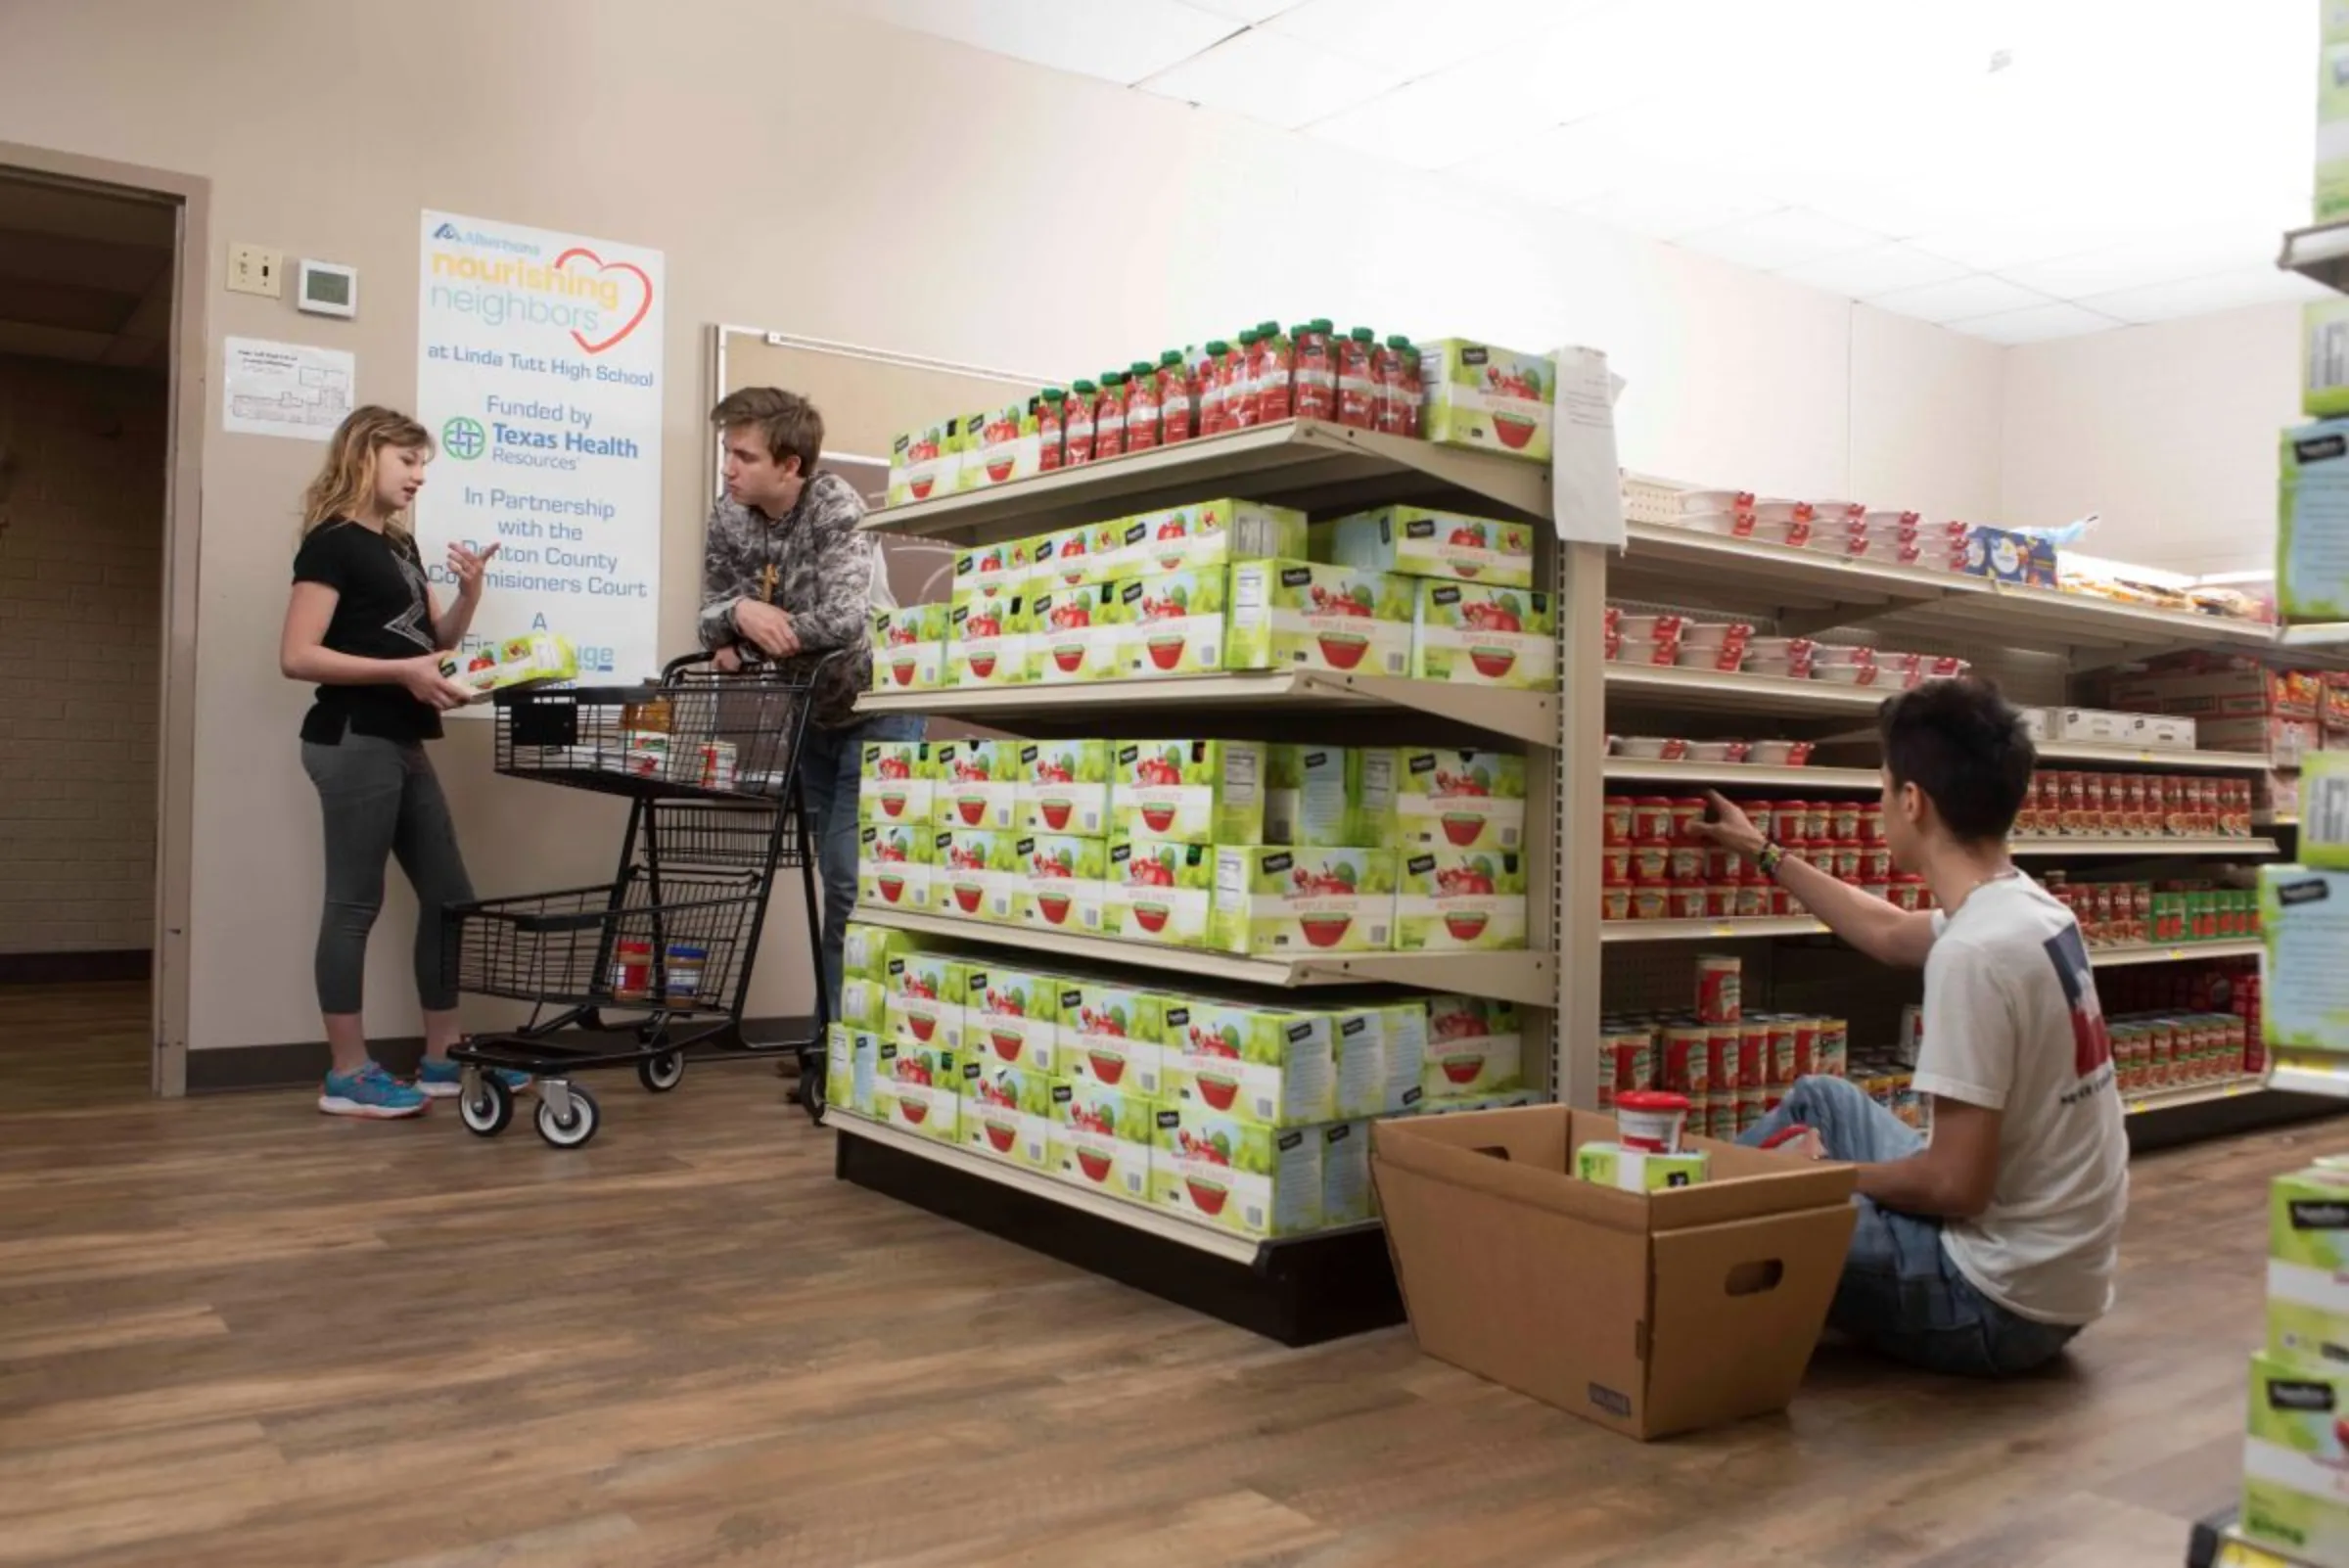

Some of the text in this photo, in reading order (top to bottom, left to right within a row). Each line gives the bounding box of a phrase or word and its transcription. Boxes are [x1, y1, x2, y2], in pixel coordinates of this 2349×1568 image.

[432, 252, 620, 310] nourishing
[431, 284, 599, 331] neighbors
[428, 345, 655, 388] at Linda Tutt High School
[486, 395, 593, 429] Funded by
[492, 422, 638, 458] Texas Health
[491, 447, 577, 471] Resources
[465, 486, 616, 522] In Partnership
[498, 519, 583, 540] with the
[545, 547, 619, 575] County
[588, 576, 648, 598] Court
[531, 612, 547, 630] A
